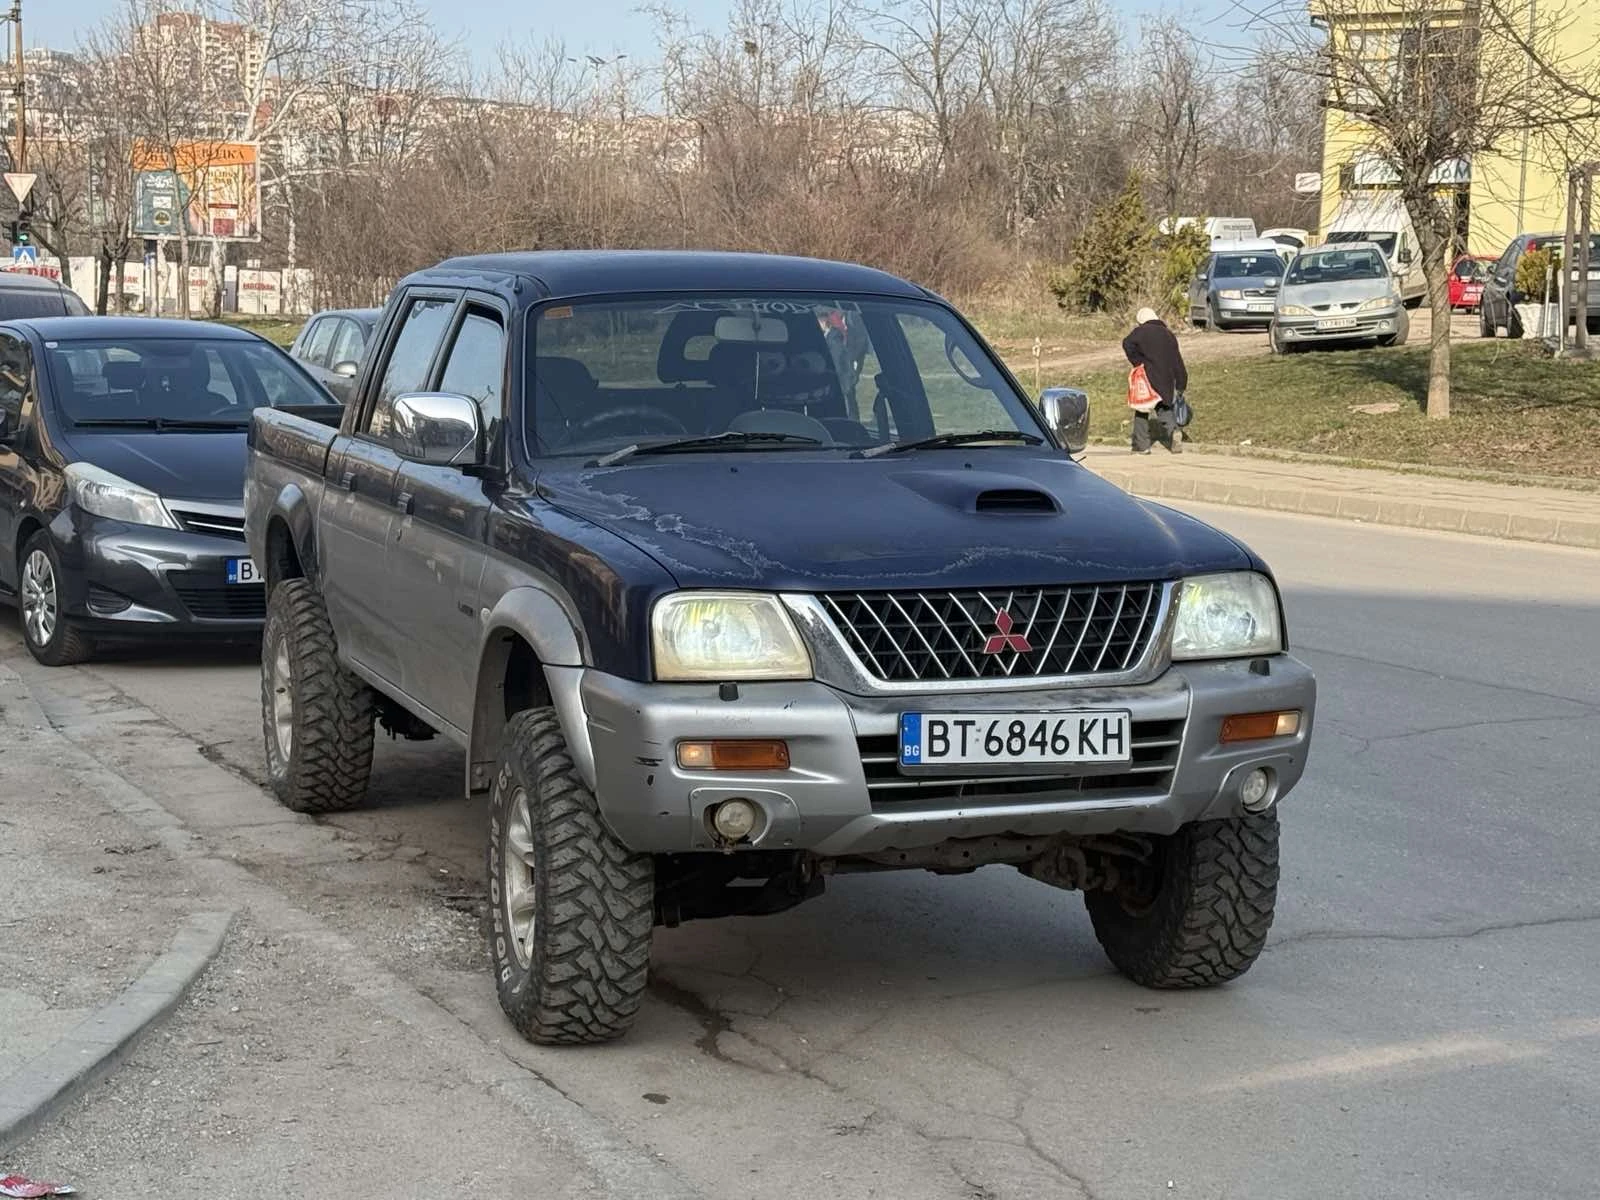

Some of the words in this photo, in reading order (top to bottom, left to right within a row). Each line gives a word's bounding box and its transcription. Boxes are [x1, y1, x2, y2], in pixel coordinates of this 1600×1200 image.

[928, 720, 976, 757] BT
[984, 719, 1070, 757] 6846
[1078, 718, 1124, 756] KH
[904, 745, 920, 757] BG
